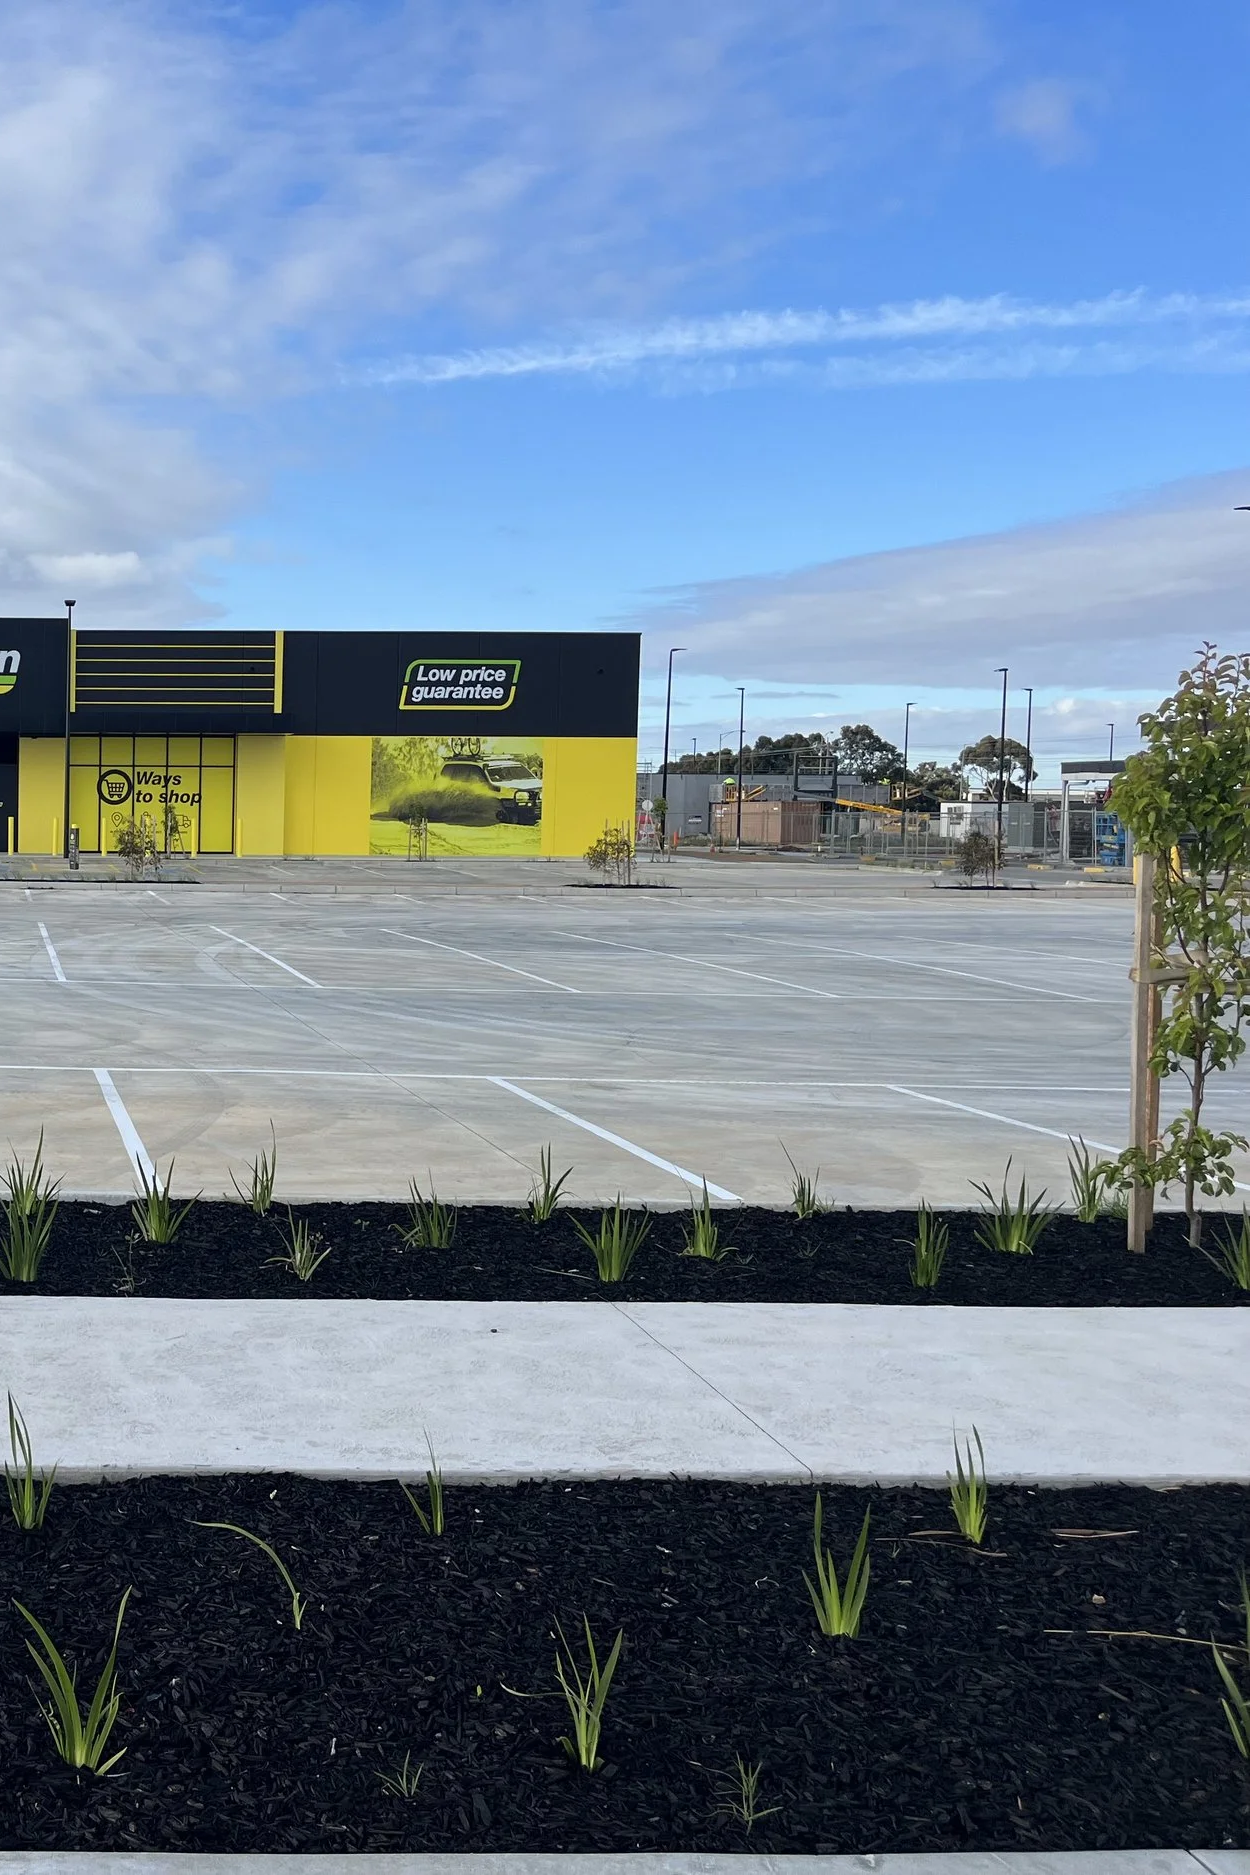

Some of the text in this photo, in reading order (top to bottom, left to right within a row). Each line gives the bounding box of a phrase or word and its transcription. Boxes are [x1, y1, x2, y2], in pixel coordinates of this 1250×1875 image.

[416, 665, 507, 685] Low price
[411, 684, 504, 702] guarantee
[136, 771, 182, 788] Ways
[135, 790, 203, 806] to shop
